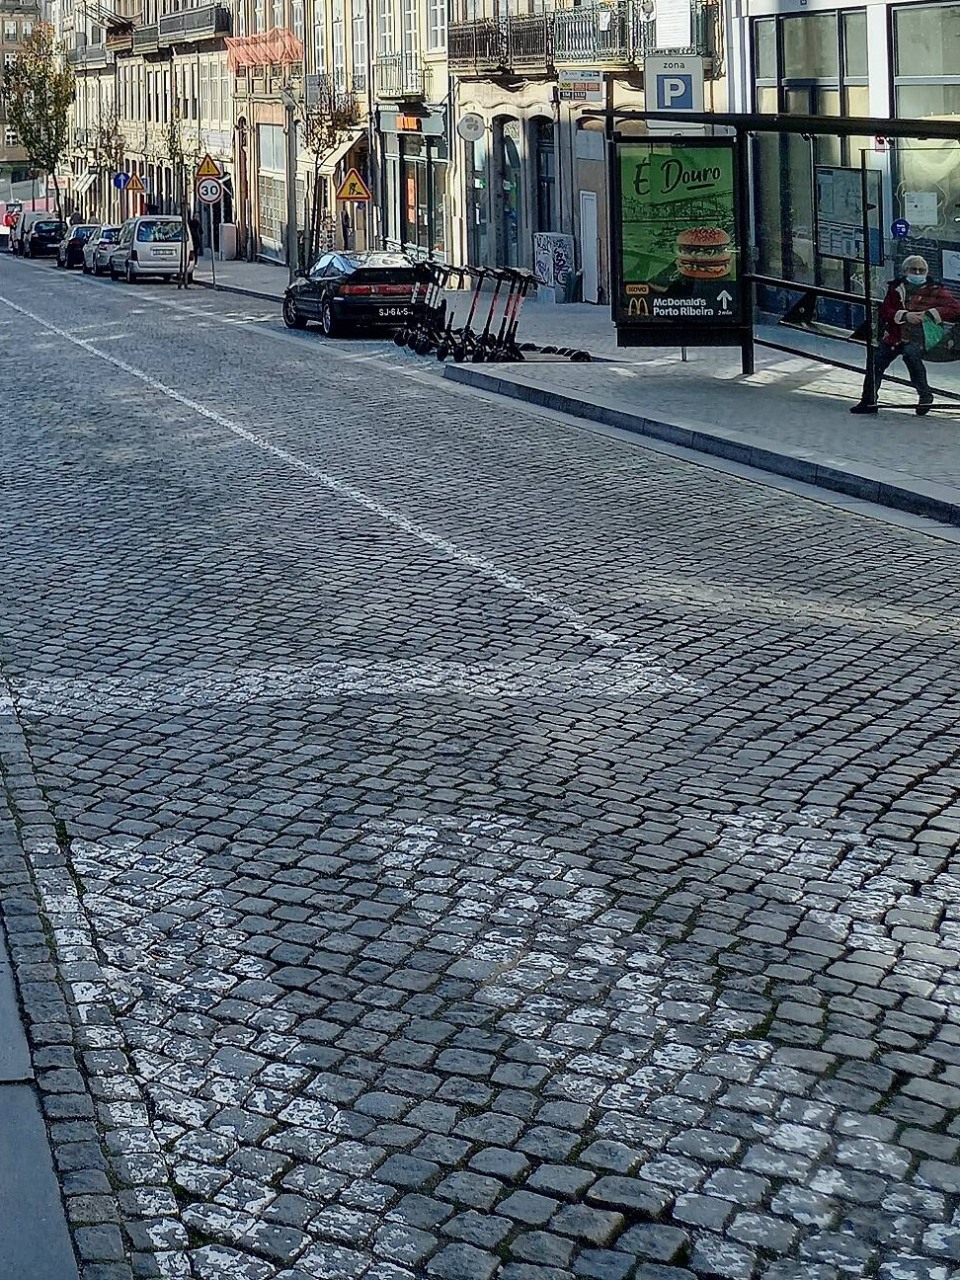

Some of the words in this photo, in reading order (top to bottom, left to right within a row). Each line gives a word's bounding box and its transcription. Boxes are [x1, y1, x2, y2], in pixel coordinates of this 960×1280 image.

[663, 61, 685, 69] zona
[664, 78, 686, 107] P
[633, 157, 651, 195] É
[660, 158, 721, 194] Douro
[201, 185, 219, 196] 30
[653, 298, 707, 306] McDonald's
[653, 307, 679, 316] Porto
[680, 306, 714, 316] Ribeira
